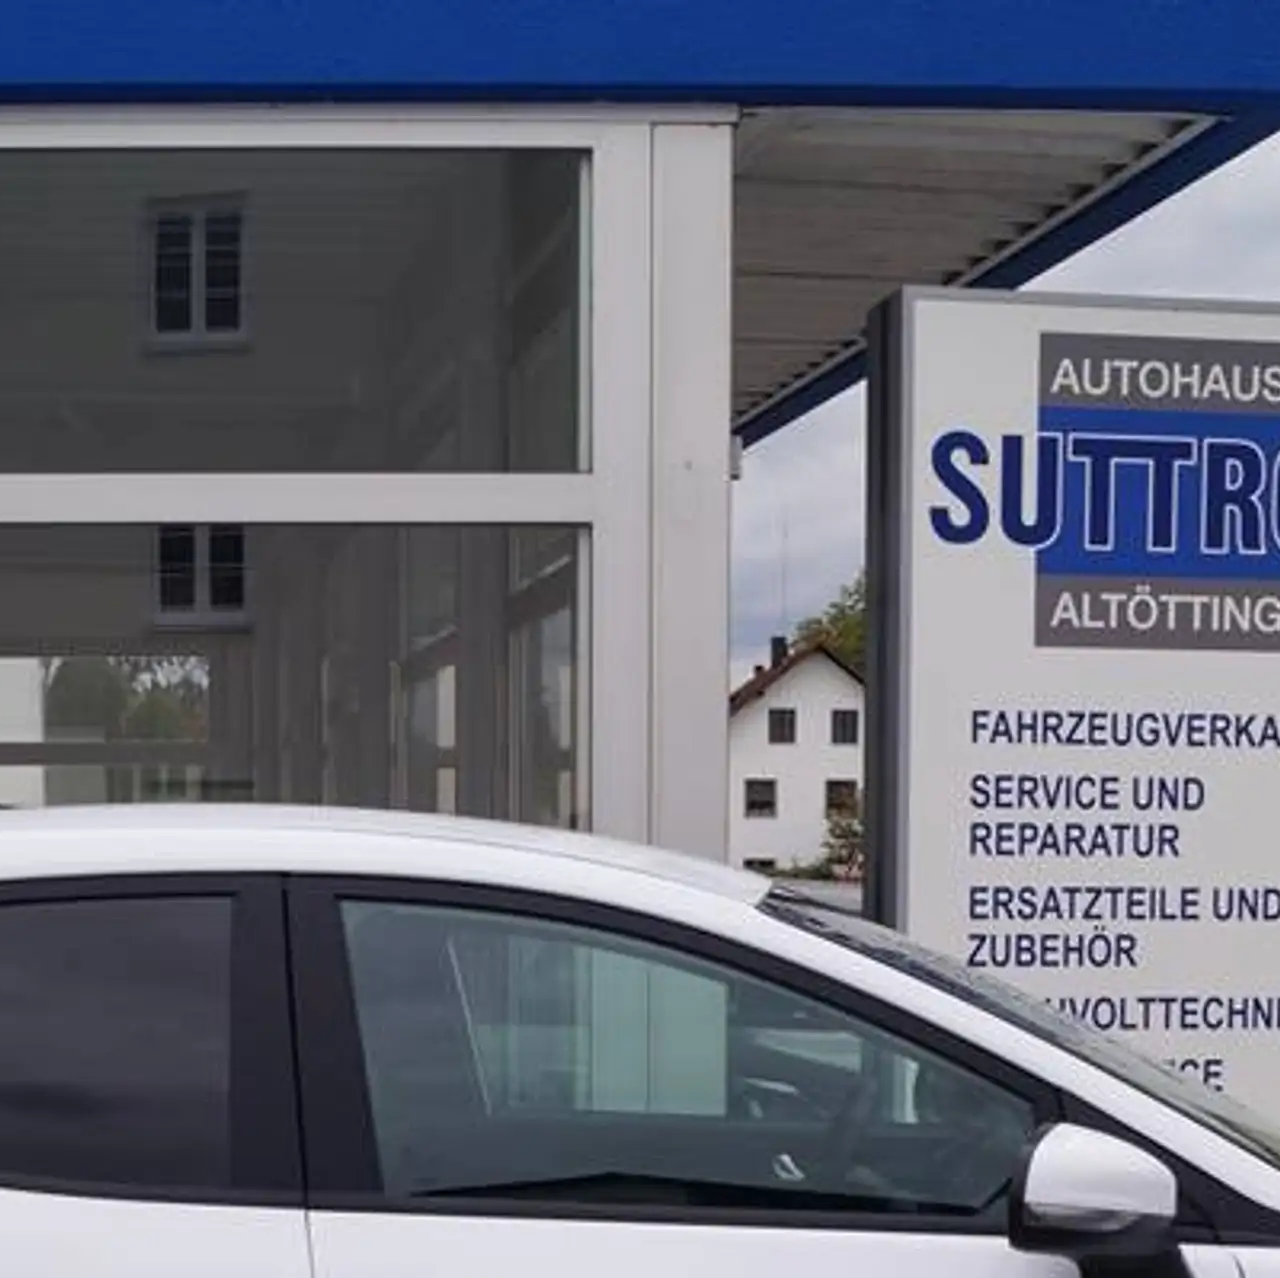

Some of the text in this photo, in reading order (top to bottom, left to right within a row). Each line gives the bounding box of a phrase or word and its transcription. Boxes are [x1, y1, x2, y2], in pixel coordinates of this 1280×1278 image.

[969, 774, 1206, 811] SERVICE UND
[969, 821, 1180, 858] REPARATUR
[968, 886, 1200, 921] ERSATZTEILE
[966, 925, 1138, 968] ZUBEHÖR
